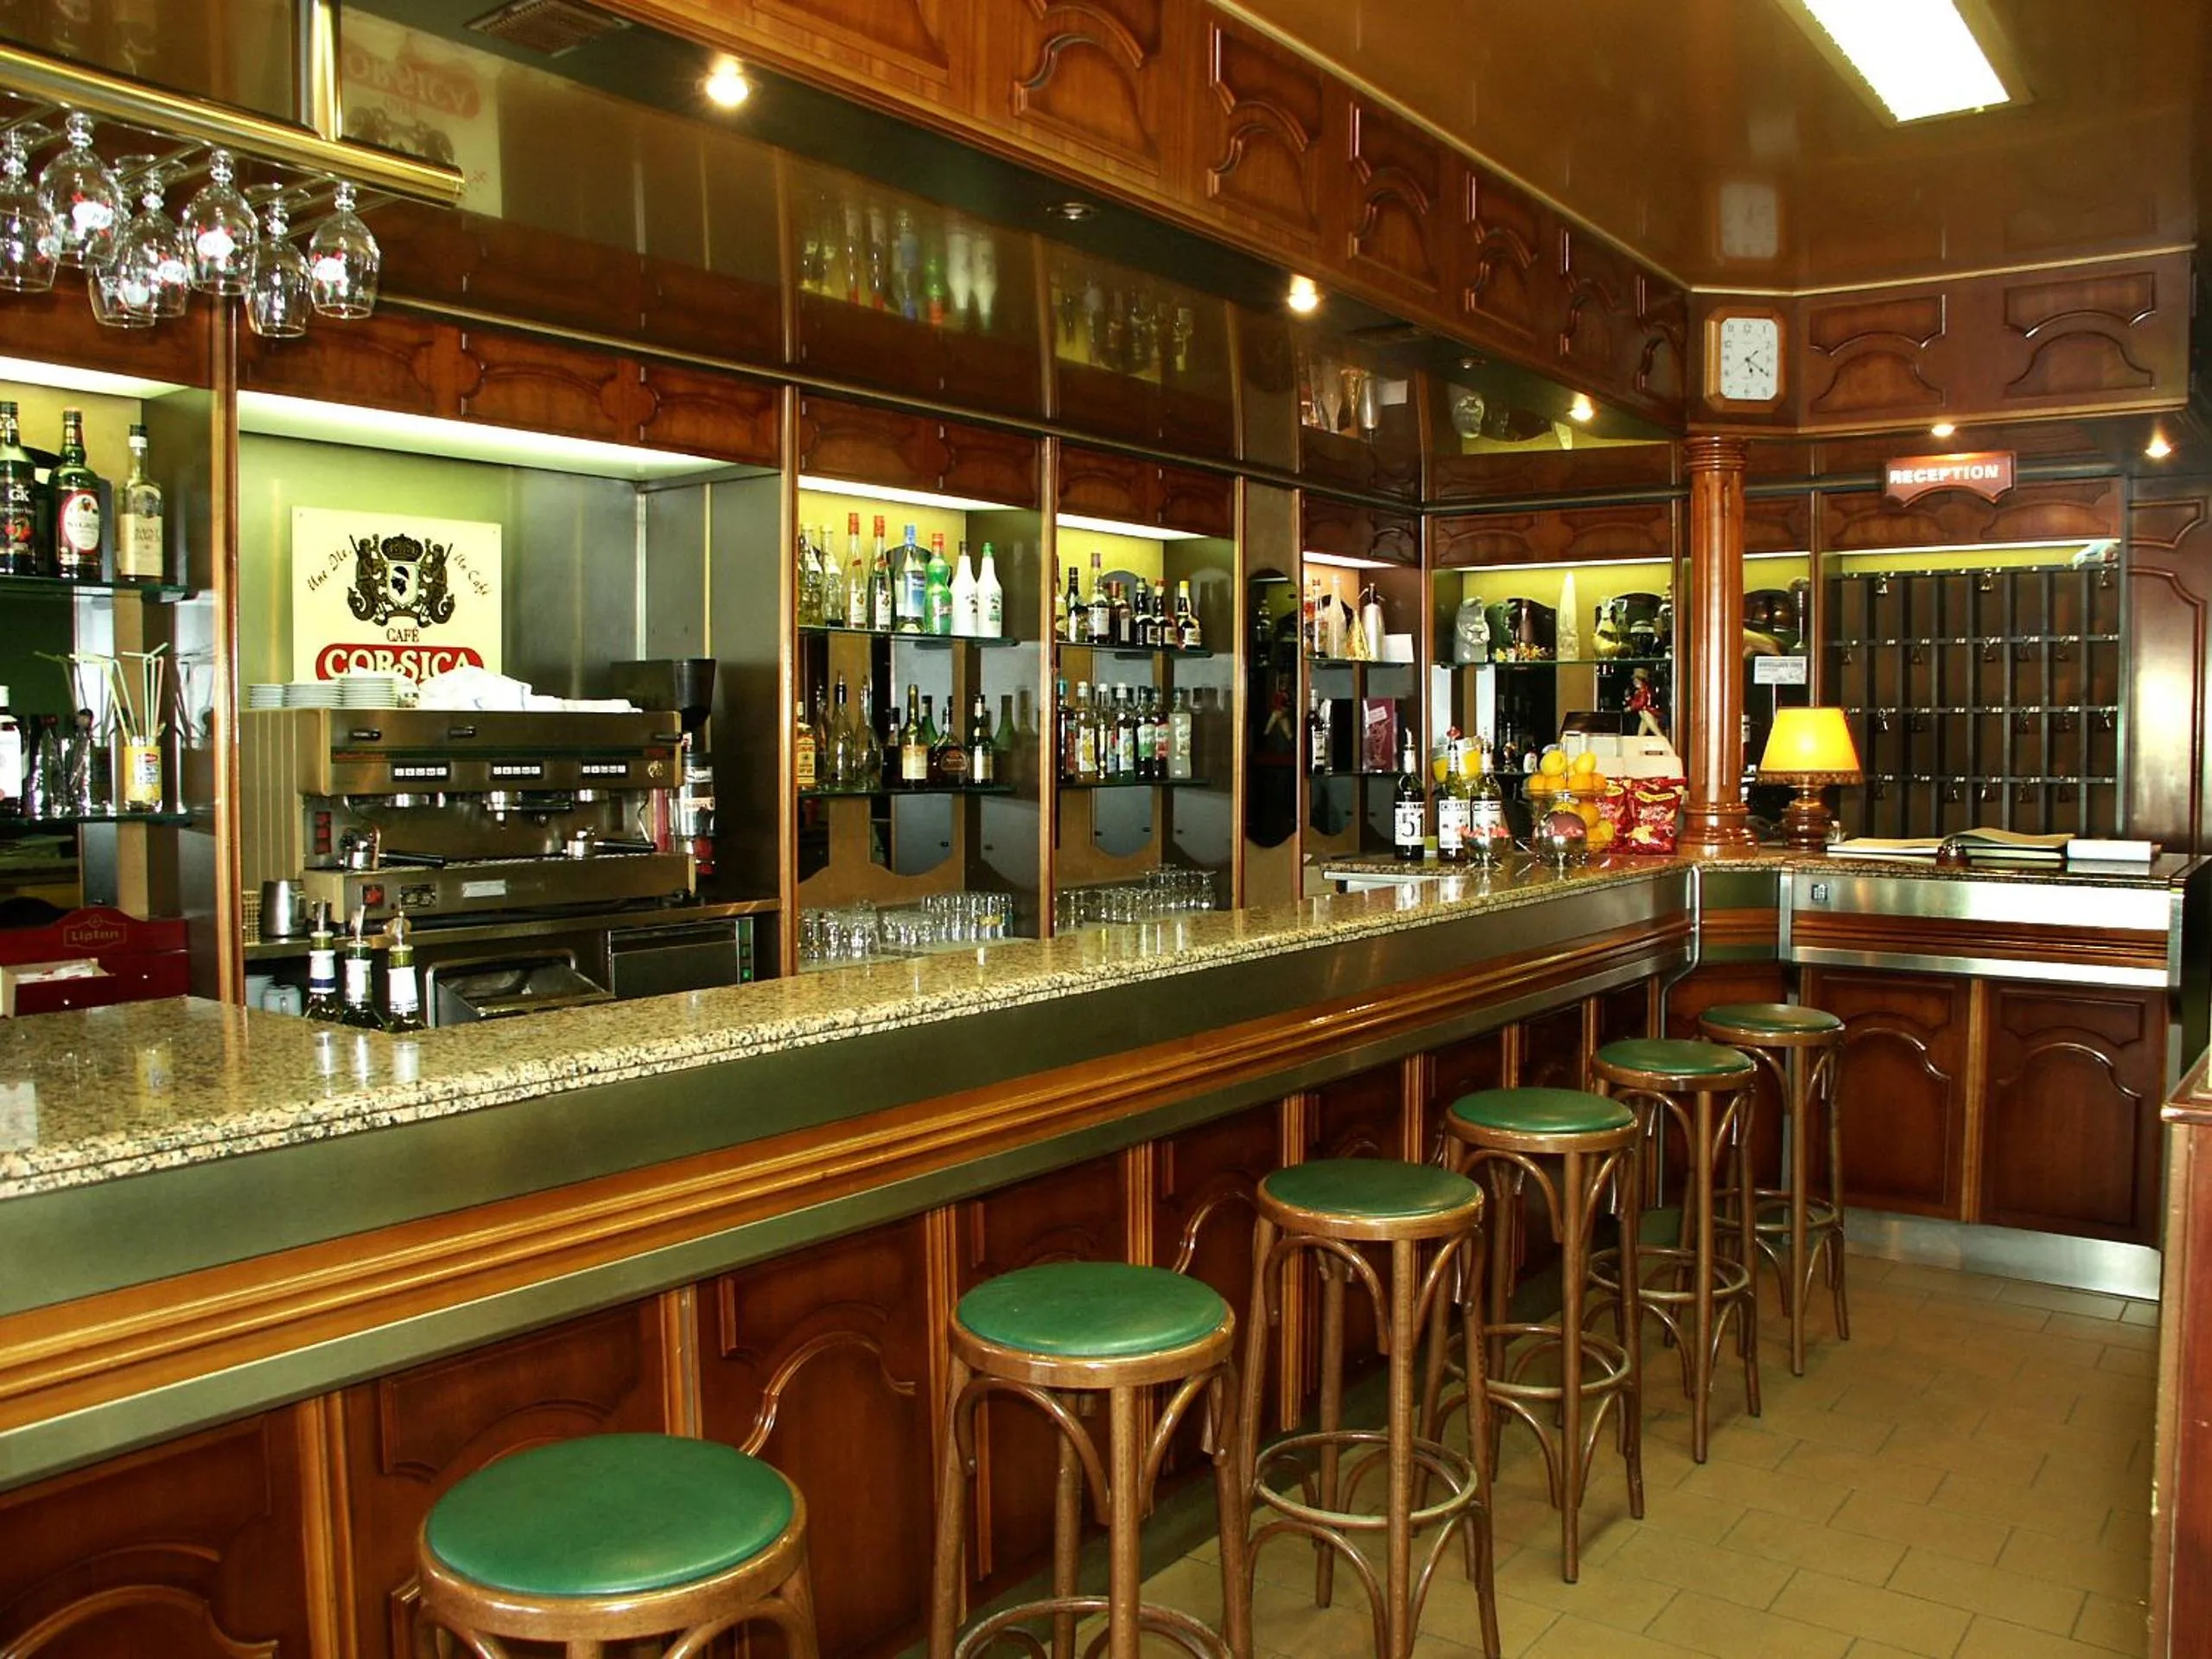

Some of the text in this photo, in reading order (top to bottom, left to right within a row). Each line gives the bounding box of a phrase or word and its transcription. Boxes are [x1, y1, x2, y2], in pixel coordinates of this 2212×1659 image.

[1890, 464, 1999, 485] RECEPTION
[386, 626, 420, 643] CAFÉ
[1402, 812, 1424, 837] 51
